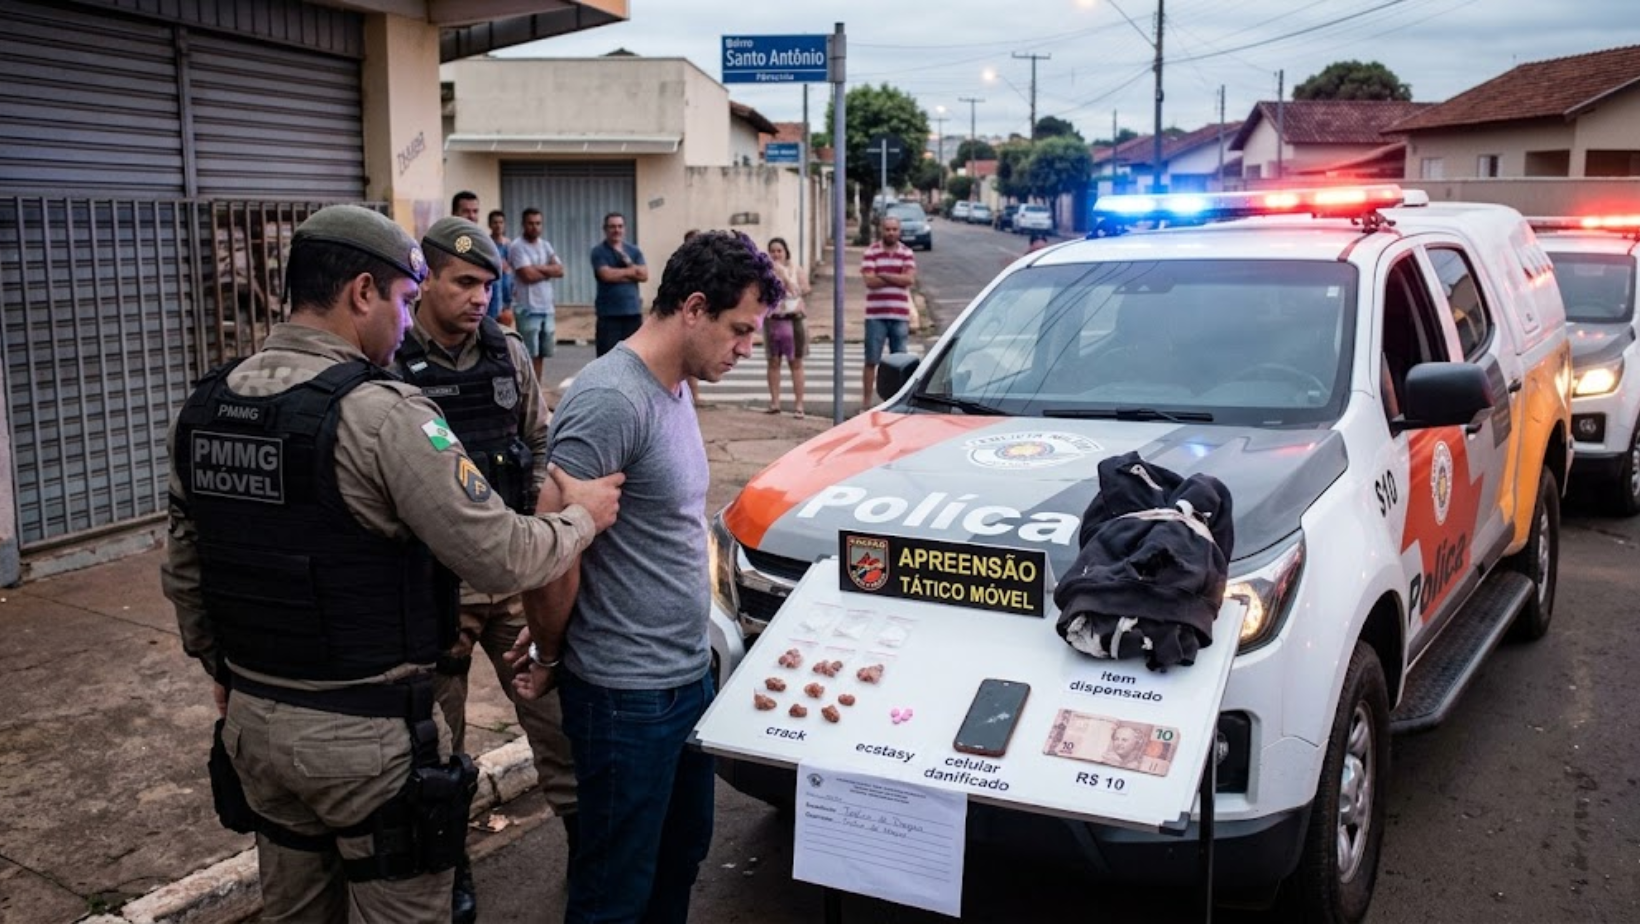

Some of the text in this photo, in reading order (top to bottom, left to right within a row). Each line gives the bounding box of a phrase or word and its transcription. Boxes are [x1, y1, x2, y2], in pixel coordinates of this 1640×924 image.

[726, 48, 824, 66] Santo Antônio
[218, 404, 259, 420] PMMG
[194, 438, 278, 471] PMMG
[195, 467, 279, 497] MÓVEL
[796, 485, 1081, 546] Políca
[898, 547, 1037, 583] APREENSÃO
[899, 573, 965, 600] TÁTICO
[970, 583, 1034, 610] MÓVEL
[766, 726, 807, 741] crack
[1155, 728, 1174, 741] 10
[855, 743, 916, 763] ecstasy
[945, 757, 1001, 774] celular
[924, 768, 1010, 791] danificado
[1105, 777, 1125, 791] 10
